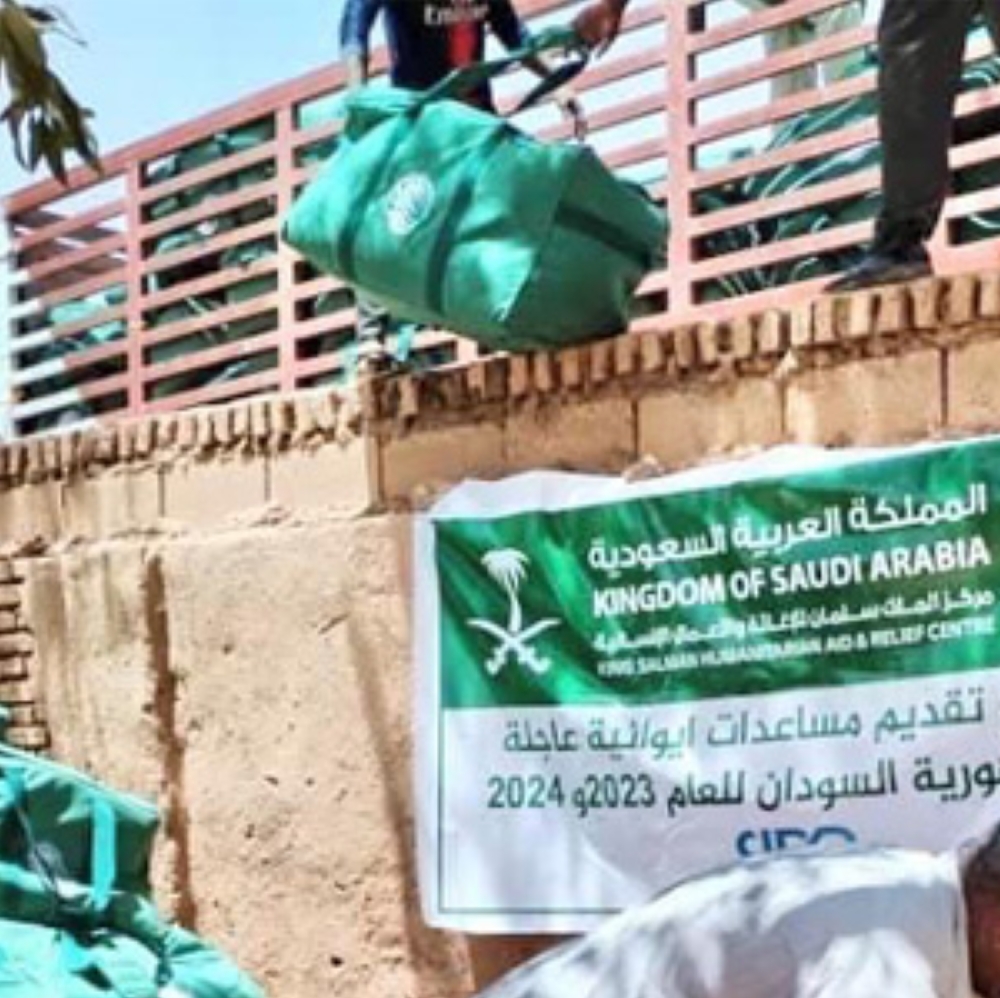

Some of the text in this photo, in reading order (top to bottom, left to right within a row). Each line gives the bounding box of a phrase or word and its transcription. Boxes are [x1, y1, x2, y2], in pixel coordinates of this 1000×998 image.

[587, 483, 987, 579] المملكة العربية السعودية
[593, 533, 991, 618] KINGDOM OF SAUDI ARABIA
[503, 717, 579, 761] عاجلة
[707, 704, 862, 747] مساعدات
[873, 686, 985, 743] تقديم
[487, 773, 565, 809] 2024
[666, 770, 745, 817] للعام
[756, 758, 898, 811] السودان
